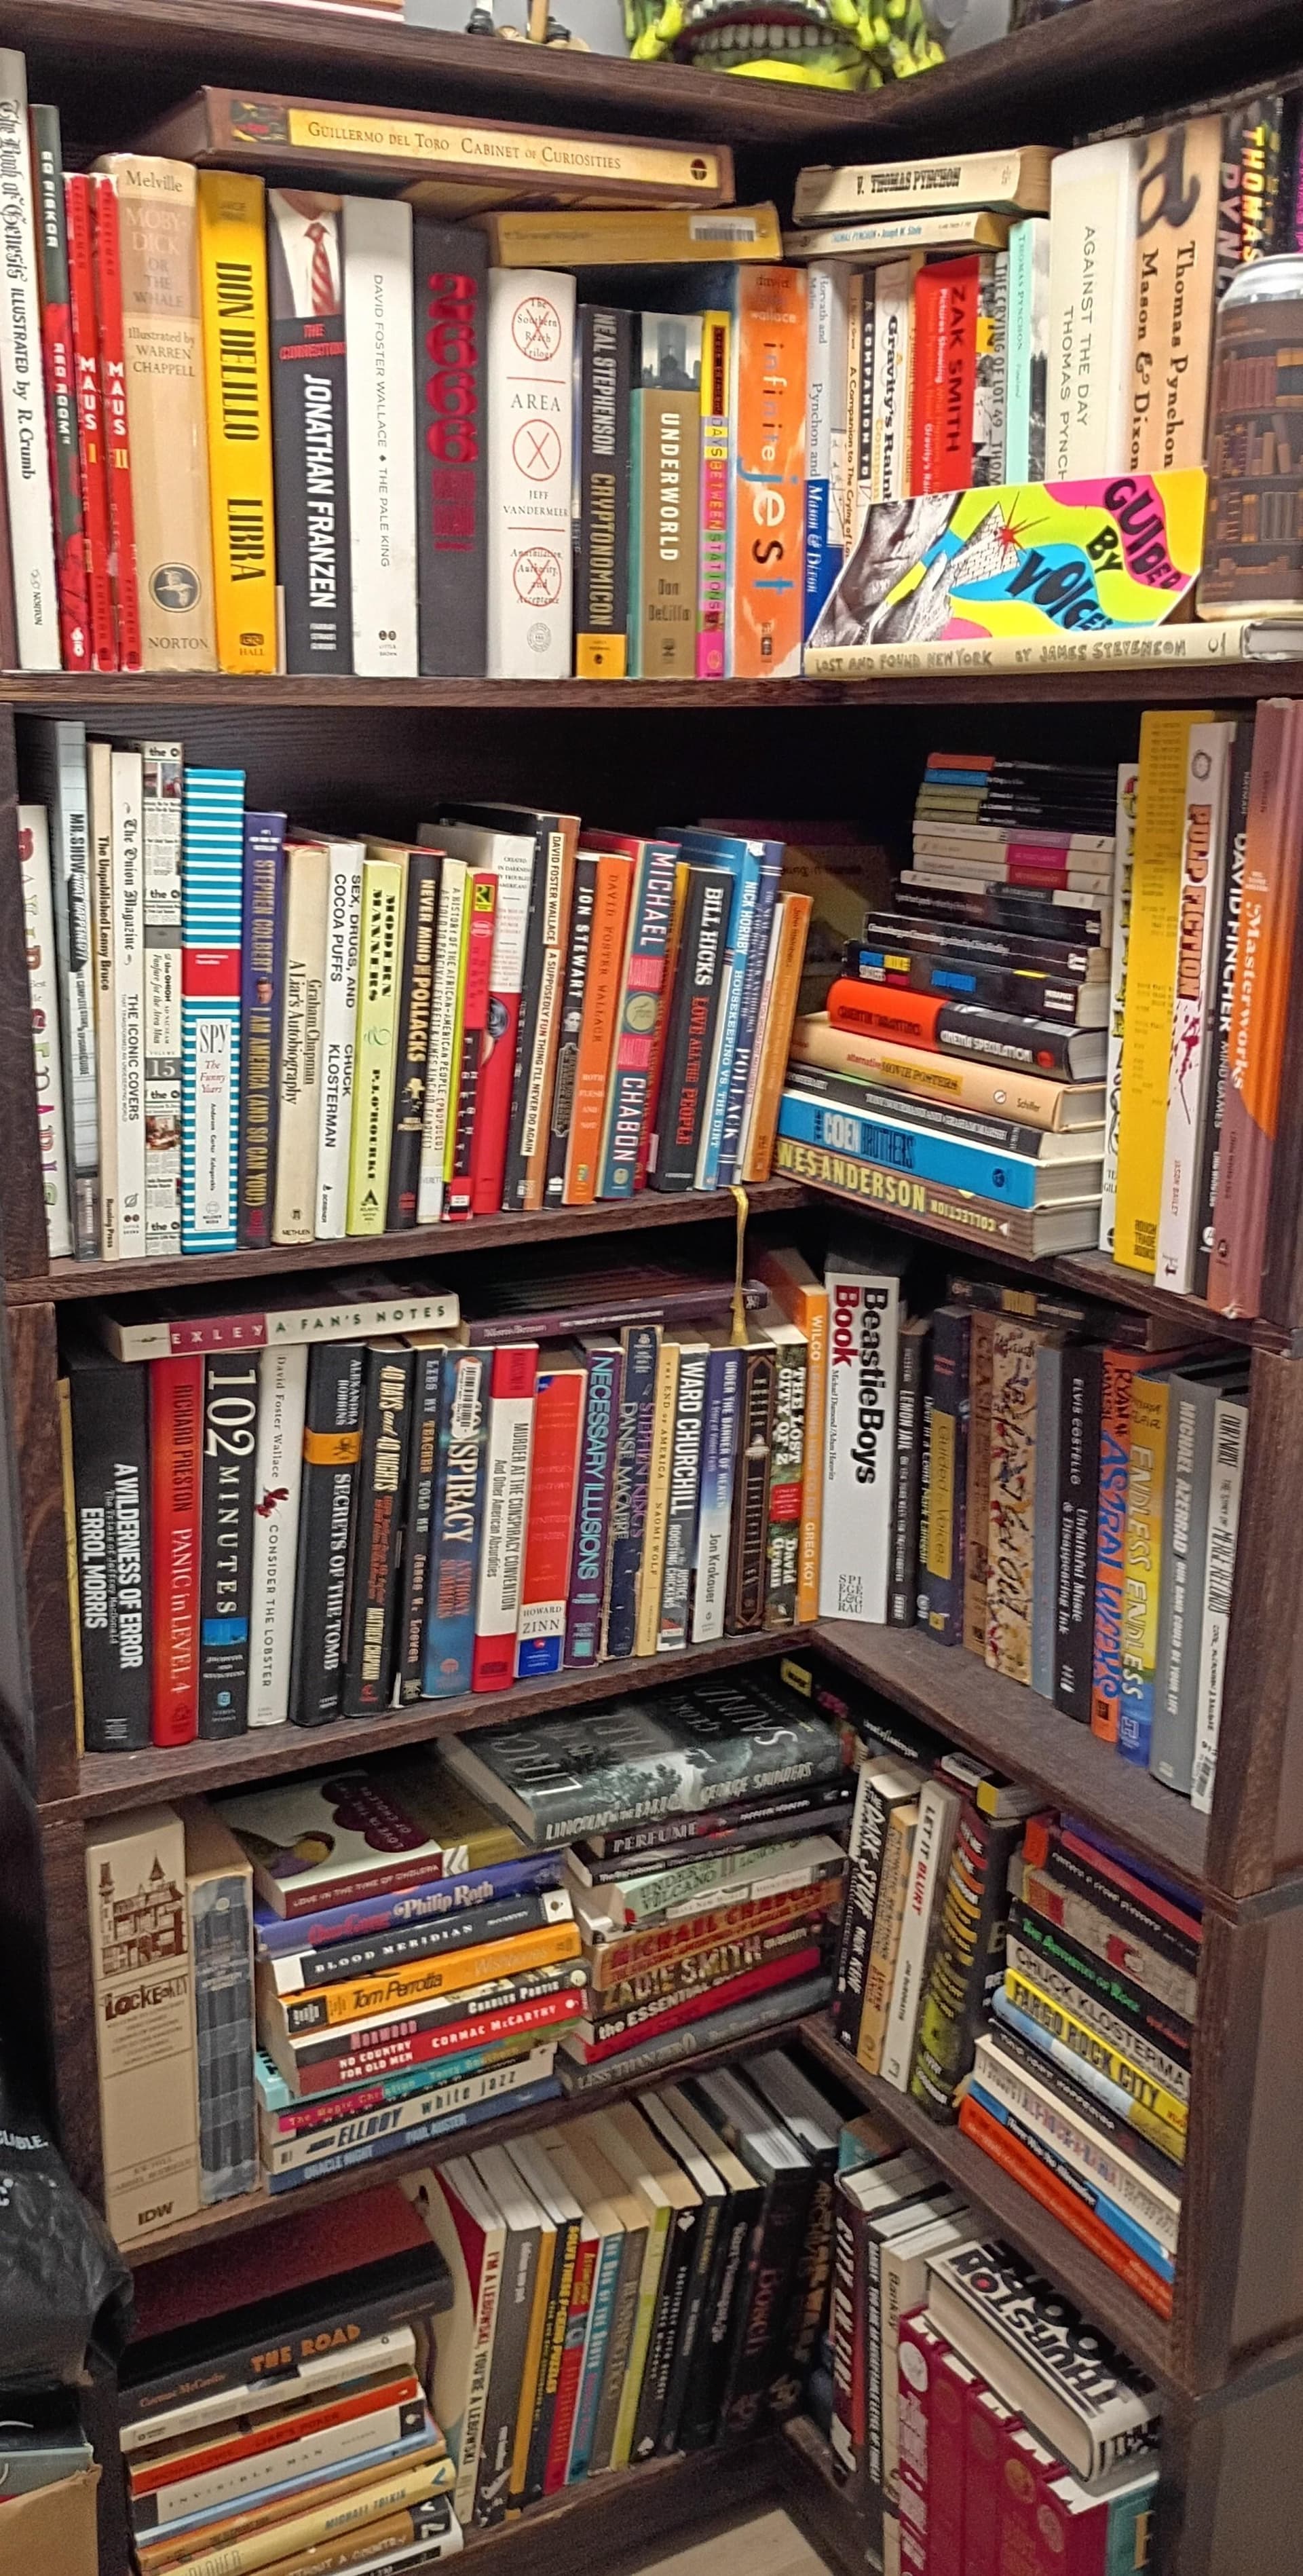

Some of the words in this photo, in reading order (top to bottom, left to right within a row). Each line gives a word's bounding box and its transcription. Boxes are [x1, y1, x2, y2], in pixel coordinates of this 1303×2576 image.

[307, 122, 383, 143] GUILLERMO
[389, 134, 411, 147] DEL
[414, 134, 449, 151] TORO
[461, 138, 519, 160] CABINET
[541, 146, 621, 170] CURIOSITIES
[126, 170, 183, 193] Melville
[1241, 126, 1266, 262] THOMAS
[373, 274, 383, 318] DAVID
[995, 264, 1008, 296] THE
[1080, 225, 1096, 324] AGAINST
[1137, 248, 1159, 341] Mason
[1171, 240, 1196, 348] Thomas
[216, 261, 257, 339] DON
[949, 286, 966, 347] ZAK
[128, 327, 182, 342] Illustrated
[183, 334, 195, 352] by
[592, 313, 617, 352] NEAL
[994, 298, 1006, 352] CRYING
[132, 360, 195, 377] CHAPPELL
[136, 344, 191, 360] WARREN
[219, 295, 263, 443] DELILLO
[374, 322, 385, 377] FOSTER
[426, 274, 480, 464] 2666
[995, 354, 1005, 371] OF
[1078, 333, 1092, 376] THE
[80, 356, 98, 430] MAUS
[108, 360, 127, 436] MAUS
[511, 393, 562, 412] AREA
[592, 355, 617, 456] STEPHENSON
[946, 358, 964, 452] SMITH
[993, 373, 1005, 405] LOT
[1076, 384, 1089, 426] DAY
[1164, 354, 1189, 468] Pynchon
[303, 373, 337, 494] JONATHAN
[376, 380, 388, 448] WALLACE
[992, 407, 1003, 428] 49
[1130, 391, 1150, 471] Dixon
[378, 468, 388, 493] THE
[529, 490, 549, 501] JEFF
[659, 413, 680, 562] UNDERWORLD
[379, 497, 389, 531] PALE
[504, 505, 569, 517] VANDERMEER
[1103, 474, 1184, 591] GUIDED
[227, 498, 267, 584] LIBRA
[306, 500, 337, 610] FRANZEN
[380, 534, 390, 568] KING
[589, 472, 616, 627] CRYPTONOMICON
[1085, 524, 1123, 574] BY
[1006, 549, 1114, 632] VOICES
[148, 635, 209, 652] NORTON
[549, 836, 561, 866] DAVID
[1185, 804, 1211, 883] PULP
[333, 874, 346, 930] COCOA
[350, 874, 360, 908] SEX,
[418, 880, 436, 922] NEVER
[548, 867, 560, 899] FOSTER
[577, 886, 594, 916] JON
[640, 851, 677, 948] MICHAEL
[741, 881, 759, 908] NICK
[546, 899, 559, 942] WALLACE
[701, 886, 724, 927] BILL
[347, 914, 360, 971] DRUGS,
[416, 926, 432, 963] MIND
[736, 911, 753, 955] HORNBY
[1176, 885, 1206, 1001] FICTION
[331, 934, 344, 983] PUFFS
[569, 924, 590, 998] STEWART
[694, 931, 719, 986] HICKS
[128, 994, 138, 1018] THE
[345, 977, 356, 1009] AND
[542, 961, 556, 1018] SUPPOSEDLY
[200, 1024, 229, 1053] SPY
[408, 975, 431, 1064] POLLACKS
[540, 1018, 549, 1036] FUN
[128, 1023, 138, 1066] ICONIC
[204, 1060, 221, 1069] The
[535, 1039, 547, 1066] THING
[151, 1060, 176, 1078] 15
[200, 1072, 226, 1084] Funny
[341, 1043, 354, 1096] CHUCK
[128, 1069, 139, 1121] COVERS
[325, 1043, 340, 1149] KLOSTERMAN
[529, 1082, 541, 1110] NEVER
[524, 1125, 535, 1153] AGAIN
[527, 1112, 537, 1125] DO
[613, 1077, 647, 1161] CHABON
[777, 1142, 816, 1178] WES
[821, 1156, 926, 1214] ANDERSON
[104, 1198, 114, 1227] Running
[171, 1325, 263, 1345] EXLEY
[275, 1321, 287, 1333] A
[301, 1311, 362, 1330] FAN'S
[376, 1304, 447, 1324] NOTES
[809, 1314, 824, 1361] WILCO
[833, 1285, 861, 1368] Book
[858, 1287, 889, 1404] Beastie
[276, 1356, 286, 1392] David
[678, 1361, 706, 1413] WARD
[204, 1369, 257, 1457] 102
[273, 1394, 285, 1429] Foster
[584, 1356, 615, 1480] NECESSARY
[271, 1431, 283, 1478] Wallace
[510, 1423, 529, 1463] MURDER
[851, 1408, 884, 1485] Boys
[1175, 1400, 1196, 1475] MICHAEL
[114, 1463, 138, 1477] A
[510, 1466, 525, 1476] AT
[510, 1476, 525, 1493] THE
[670, 1418, 702, 1516] CHURCHILL
[504, 1495, 524, 1556] CONSPIRACY
[1127, 1444, 1153, 1571] ENDLESS
[1171, 1478, 1192, 1556] AZERRAD
[80, 1508, 105, 1562] ERROL
[115, 1477, 141, 1586] WILDERNESS
[216, 1465, 240, 1614] MINUTES
[576, 1482, 605, 1581] ILLUSIONS
[709, 1534, 722, 1553] Jon
[804, 1522, 816, 1560] GREG
[266, 1525, 278, 1594] CONSIDER
[705, 1554, 720, 1603] Krakauer
[801, 1563, 815, 1588] KOT
[83, 1564, 108, 1629] MORRIS
[118, 1588, 141, 1611] OF
[500, 1557, 519, 1611] CONVENTION
[264, 1599, 276, 1624] THE
[523, 1606, 562, 1618] HOWARD
[523, 1619, 561, 1635] ZINN
[119, 1613, 144, 1669] ERROR
[262, 1630, 274, 1687] LOBSTER
[1120, 1575, 1148, 1701] ENDLESS
[613, 1821, 698, 1853] PERFUME
[924, 1804, 937, 1833] LET
[924, 1838, 933, 1861] IT
[394, 1894, 452, 1919] Philip
[453, 1881, 494, 1905] Roth
[911, 1863, 928, 1916] BLURT
[314, 1952, 375, 1974] BLOOD
[381, 1924, 474, 1955] MERIDIAN
[352, 1987, 383, 2009] Tom
[384, 1972, 443, 2002] Perrotta
[431, 2025, 485, 2048] CORMAC
[491, 2005, 557, 2032] McCARTHY
[340, 2055, 356, 2070] NO
[360, 2040, 412, 2064] COUNTRY
[340, 2069, 362, 2080] FOR
[365, 2060, 388, 2074] OLD
[390, 2052, 413, 2068] MEN
[420, 2086, 471, 2116] white
[480, 2070, 516, 2096] jazz
[1118, 2057, 1160, 2105] CITY
[337, 2106, 403, 2148] ELLROY
[137, 2201, 174, 2226] IDW
[250, 2347, 292, 2373] THE
[300, 2324, 361, 2357] ROAD
[286, 2448, 324, 2467] MAN
